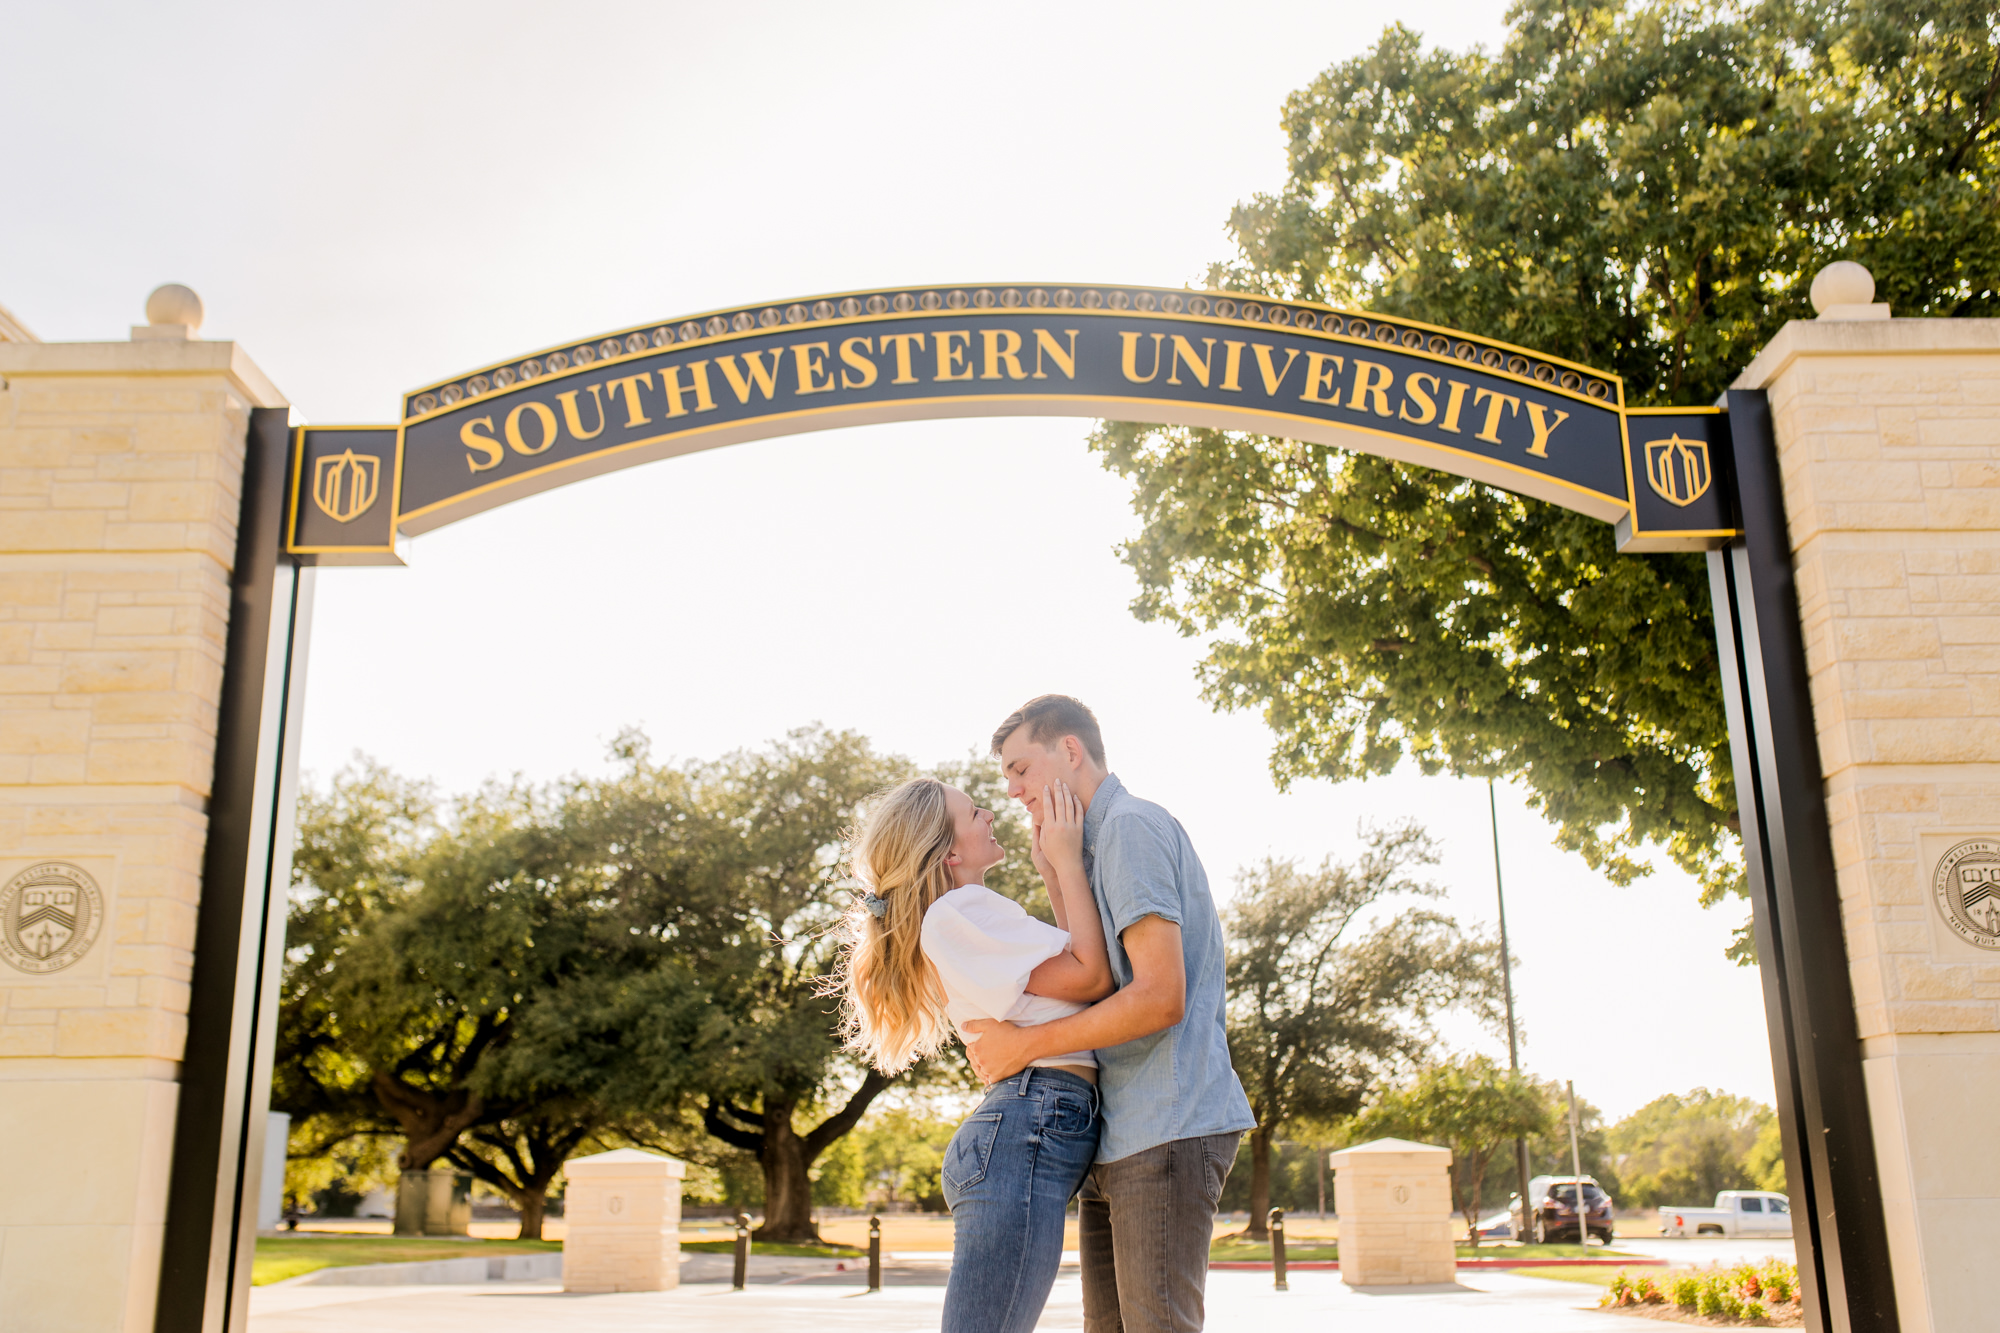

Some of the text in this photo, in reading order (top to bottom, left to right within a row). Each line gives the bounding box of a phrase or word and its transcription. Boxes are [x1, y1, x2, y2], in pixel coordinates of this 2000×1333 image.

[459, 329, 1570, 473] SOUTHWESTERN UNIVERSITY
[1949, 916, 1996, 946] NON QUIS
